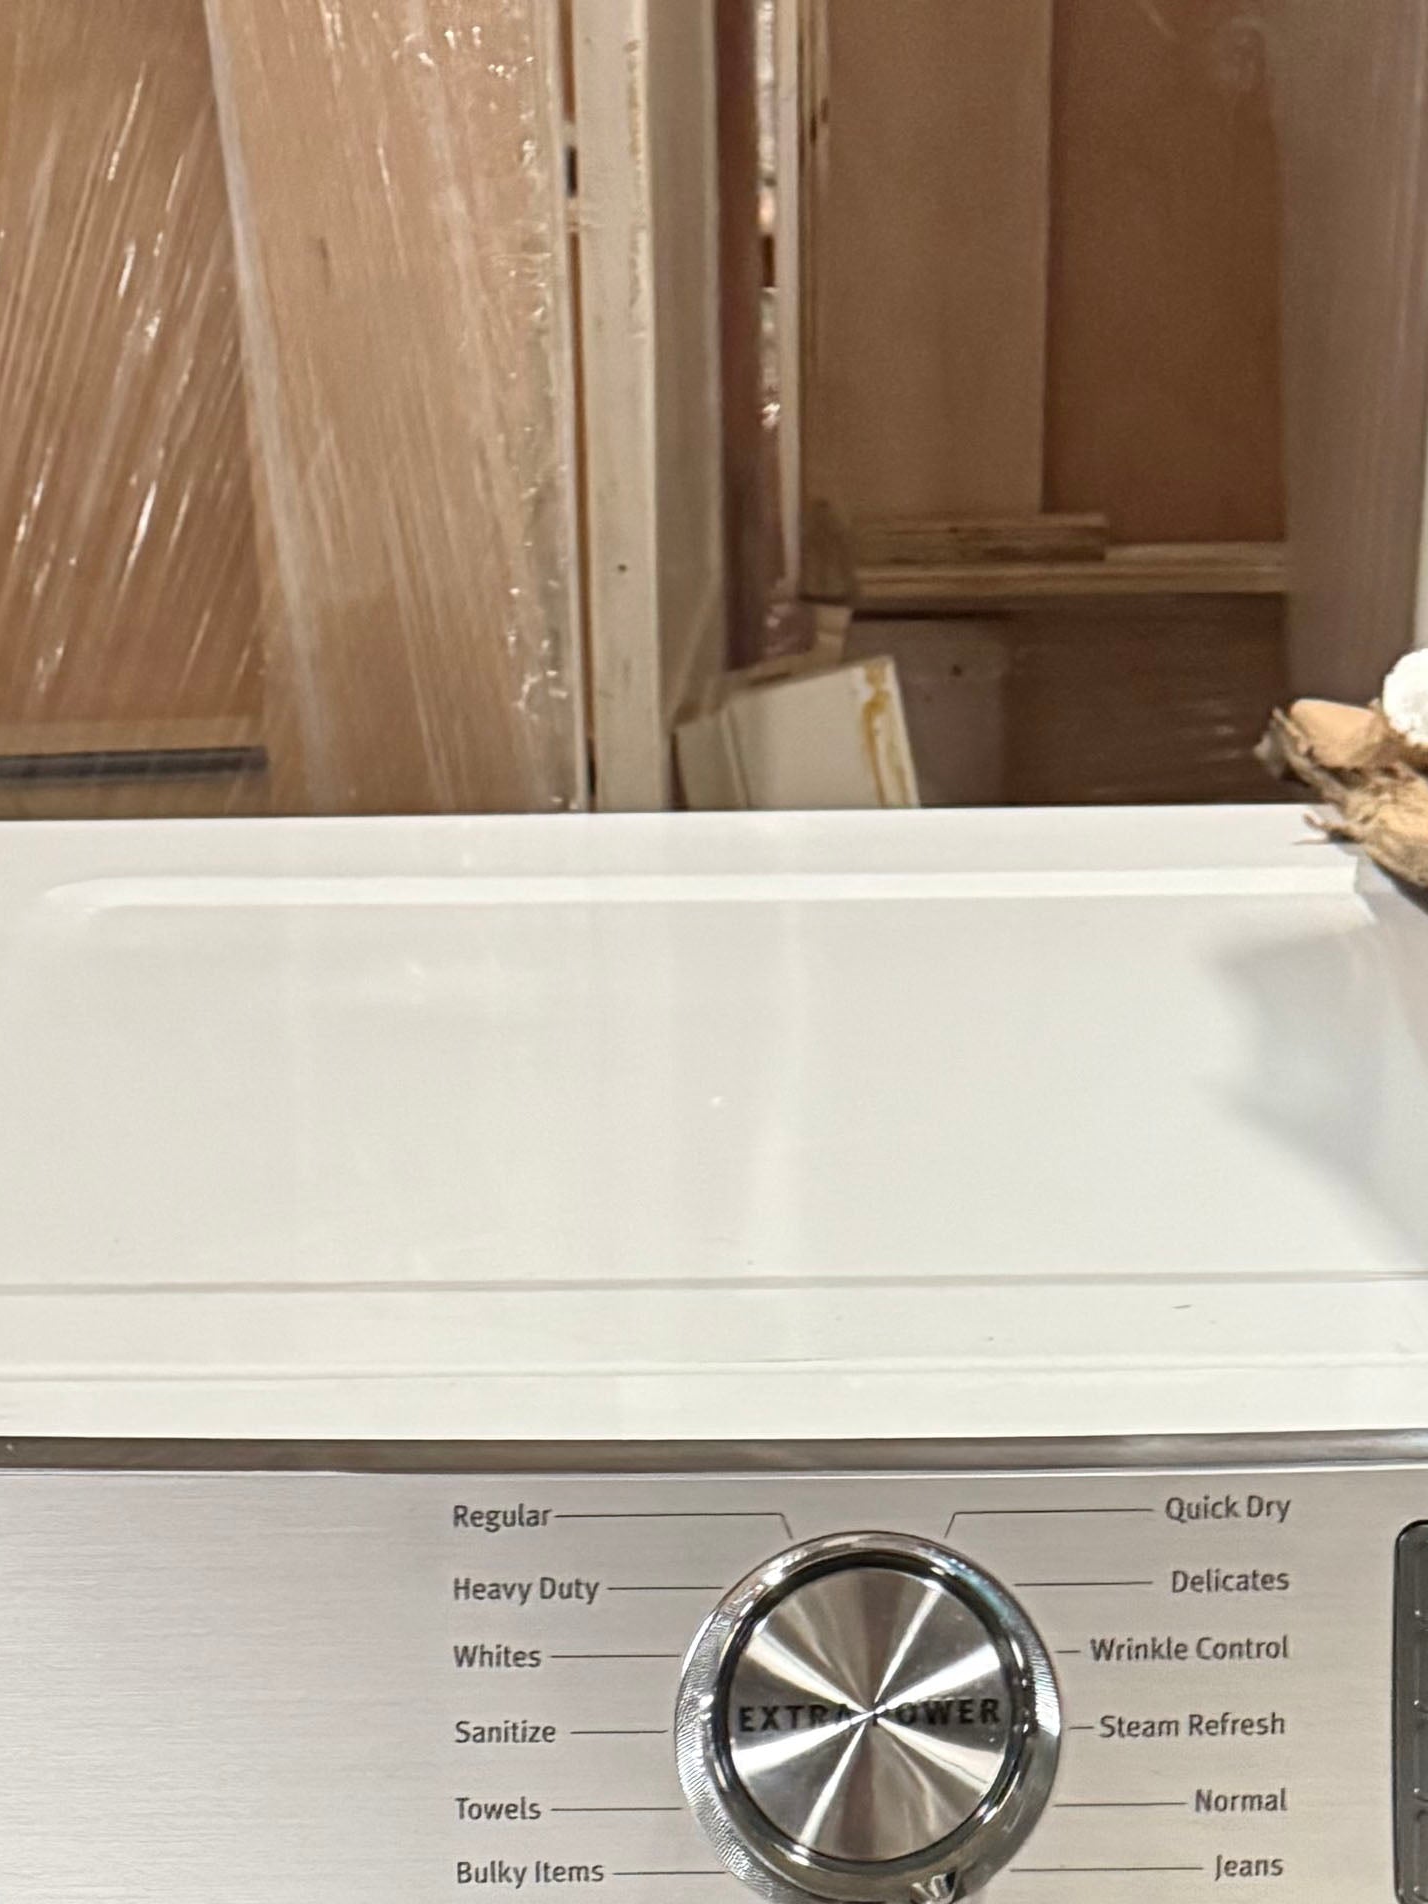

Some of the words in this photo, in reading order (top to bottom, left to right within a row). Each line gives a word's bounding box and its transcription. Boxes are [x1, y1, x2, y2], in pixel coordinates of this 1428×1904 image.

[453, 1503, 552, 1533] Regular
[1165, 1494, 1240, 1524] Quick
[1246, 1494, 1291, 1524] Dry
[453, 1577, 533, 1606] Heavy
[539, 1576, 600, 1605] Duty
[1172, 1568, 1290, 1593] Delicates
[453, 1644, 542, 1668] Whites
[1090, 1636, 1189, 1662] Wrinkle
[1195, 1634, 1289, 1660] Control
[737, 1702, 851, 1733] EXTRA
[1099, 1715, 1180, 1738] Steam
[1188, 1712, 1286, 1737] Refresh
[454, 1720, 557, 1744] Sanitize
[454, 1796, 542, 1820] Towels
[1195, 1788, 1288, 1812] Normal
[456, 1860, 527, 1889] Bulky
[534, 1861, 605, 1884] Items
[1214, 1855, 1285, 1882] Jeans
